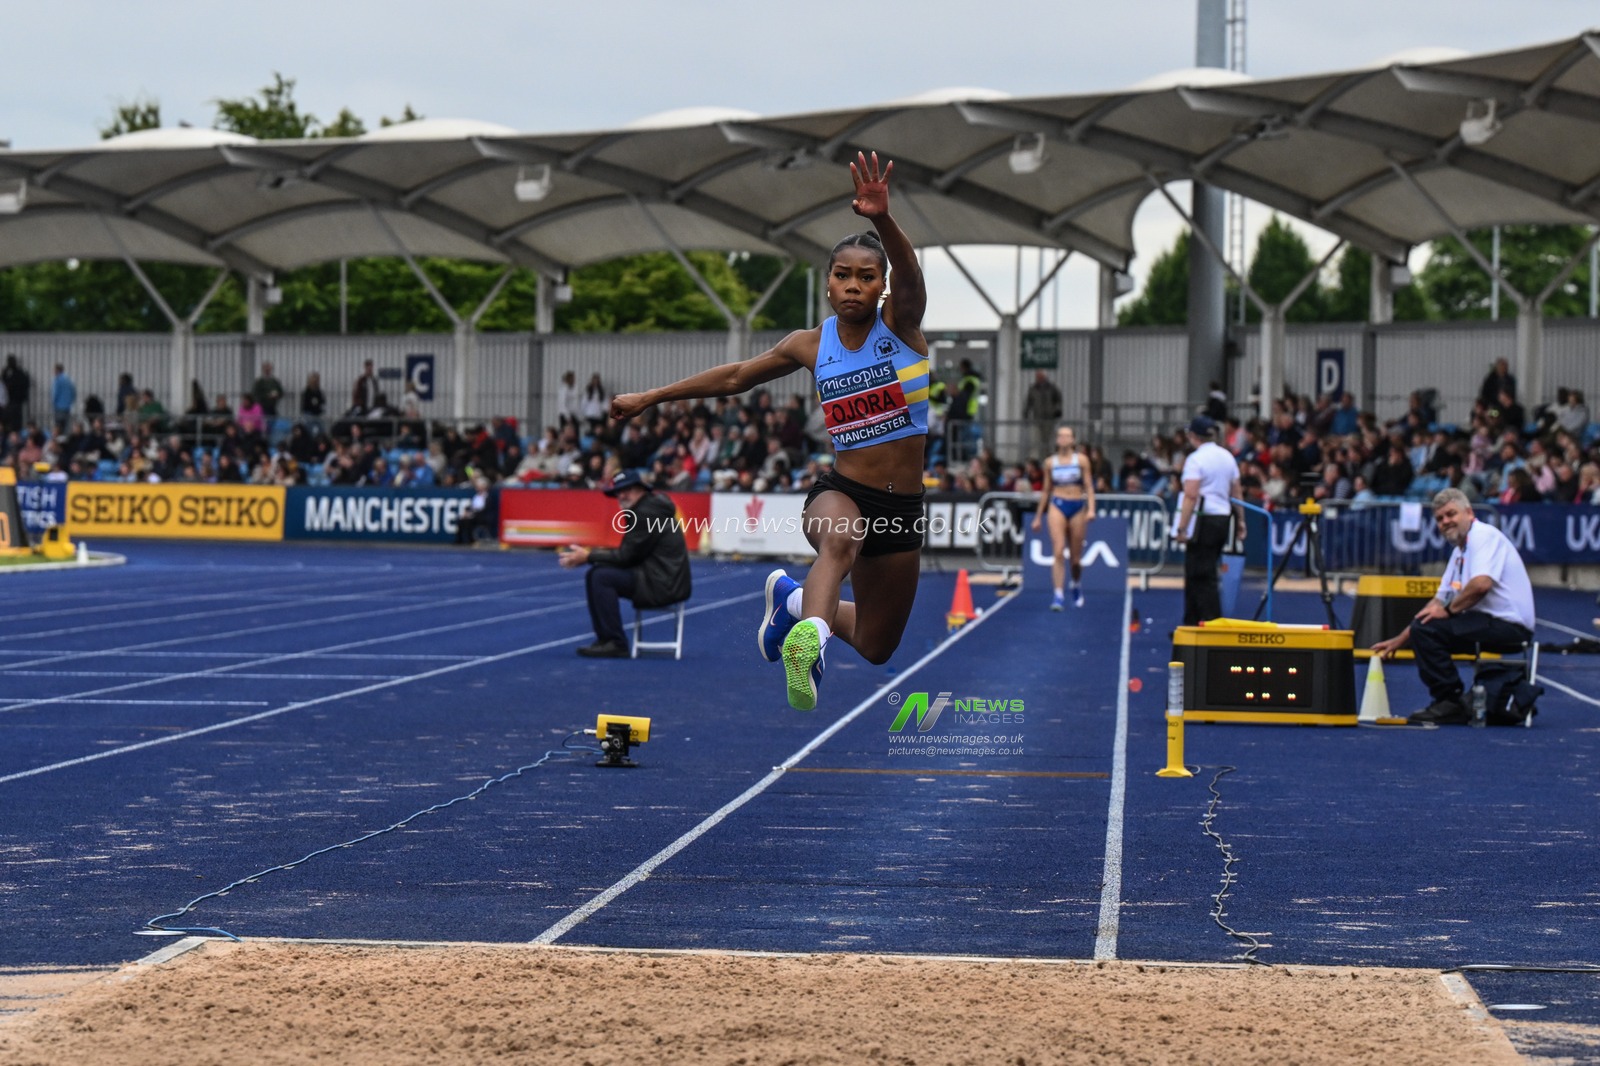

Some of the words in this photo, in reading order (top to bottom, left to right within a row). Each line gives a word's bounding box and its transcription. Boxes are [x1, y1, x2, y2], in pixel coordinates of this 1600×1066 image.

[412, 362, 430, 393] C
[835, 384, 867, 395] PROCESSING
[1321, 359, 1340, 391] D
[832, 390, 897, 423] OJORA
[835, 415, 907, 444] MANCHESTER
[71, 494, 172, 525] SEIKO
[179, 494, 280, 528] SEIKO
[1237, 633, 1285, 645] SEIKO
